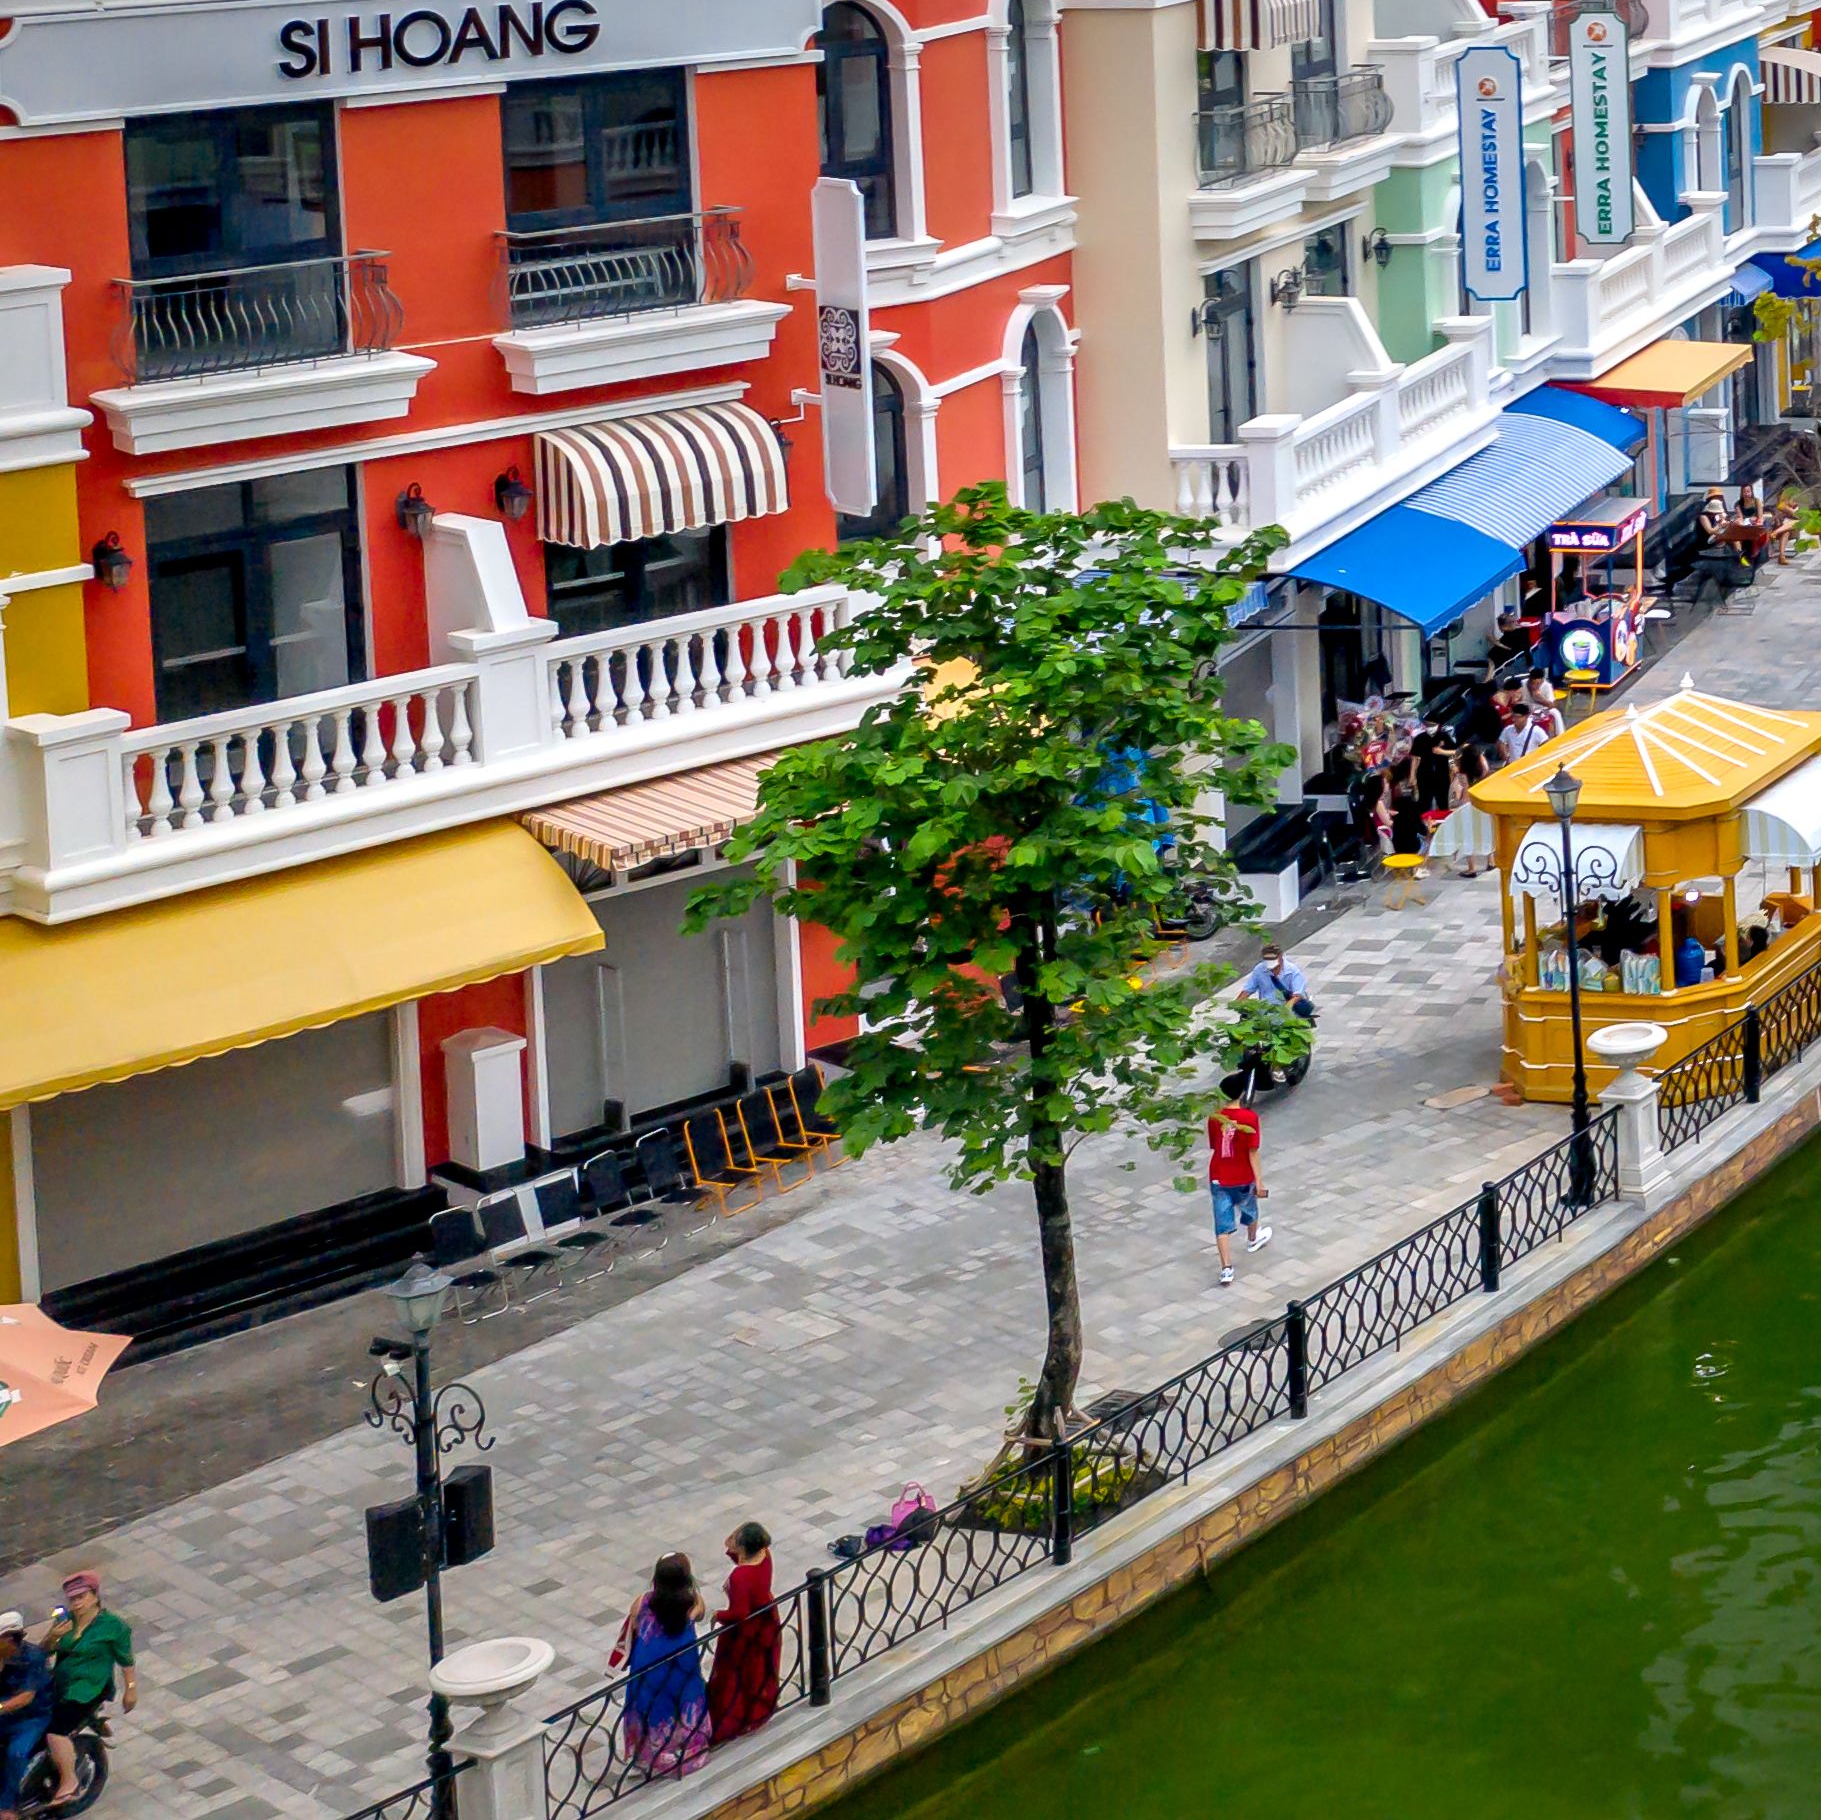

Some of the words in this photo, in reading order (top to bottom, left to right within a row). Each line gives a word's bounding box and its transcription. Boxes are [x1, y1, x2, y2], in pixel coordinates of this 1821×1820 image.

[277, 16, 331, 79] SI
[1591, 52, 1610, 172] HOMESTAY
[1481, 108, 1500, 213] HOMESTAY
[1596, 177, 1613, 235] ERRA
[1485, 220, 1500, 272] ERRA
[1552, 532, 1580, 546] TRÀ
